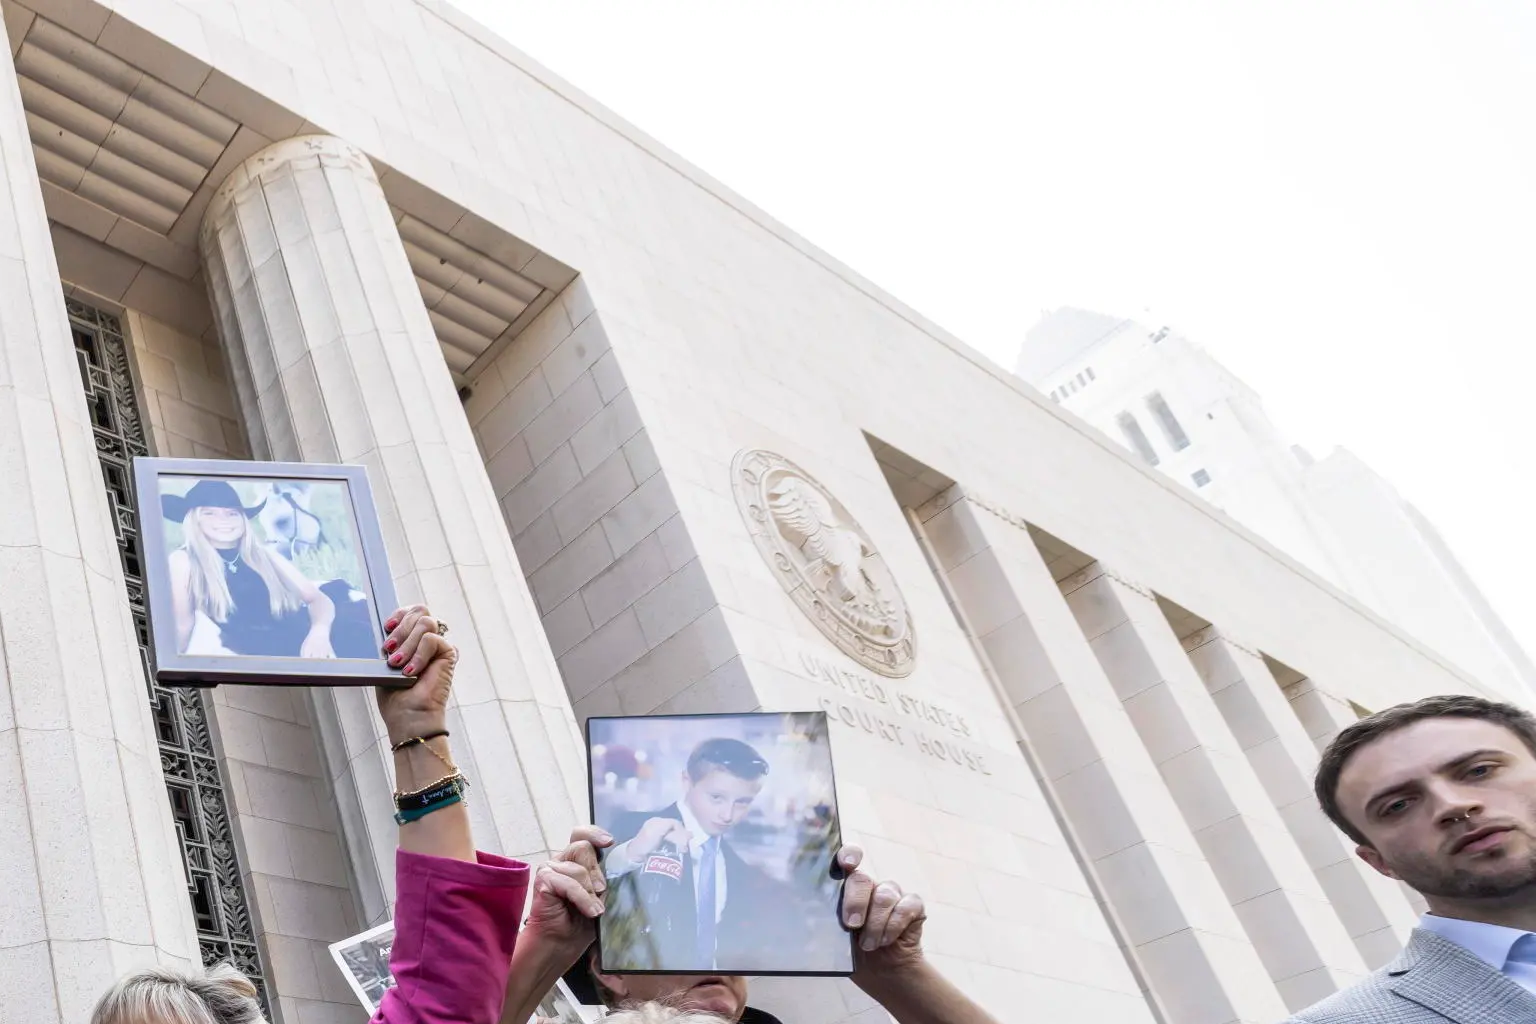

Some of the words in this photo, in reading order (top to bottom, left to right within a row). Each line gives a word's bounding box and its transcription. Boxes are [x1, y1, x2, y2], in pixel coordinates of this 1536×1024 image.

[798, 651, 886, 704] UNITED
[896, 691, 970, 737] STATES
[818, 695, 904, 746] COURT
[912, 729, 994, 776] HOUSE
